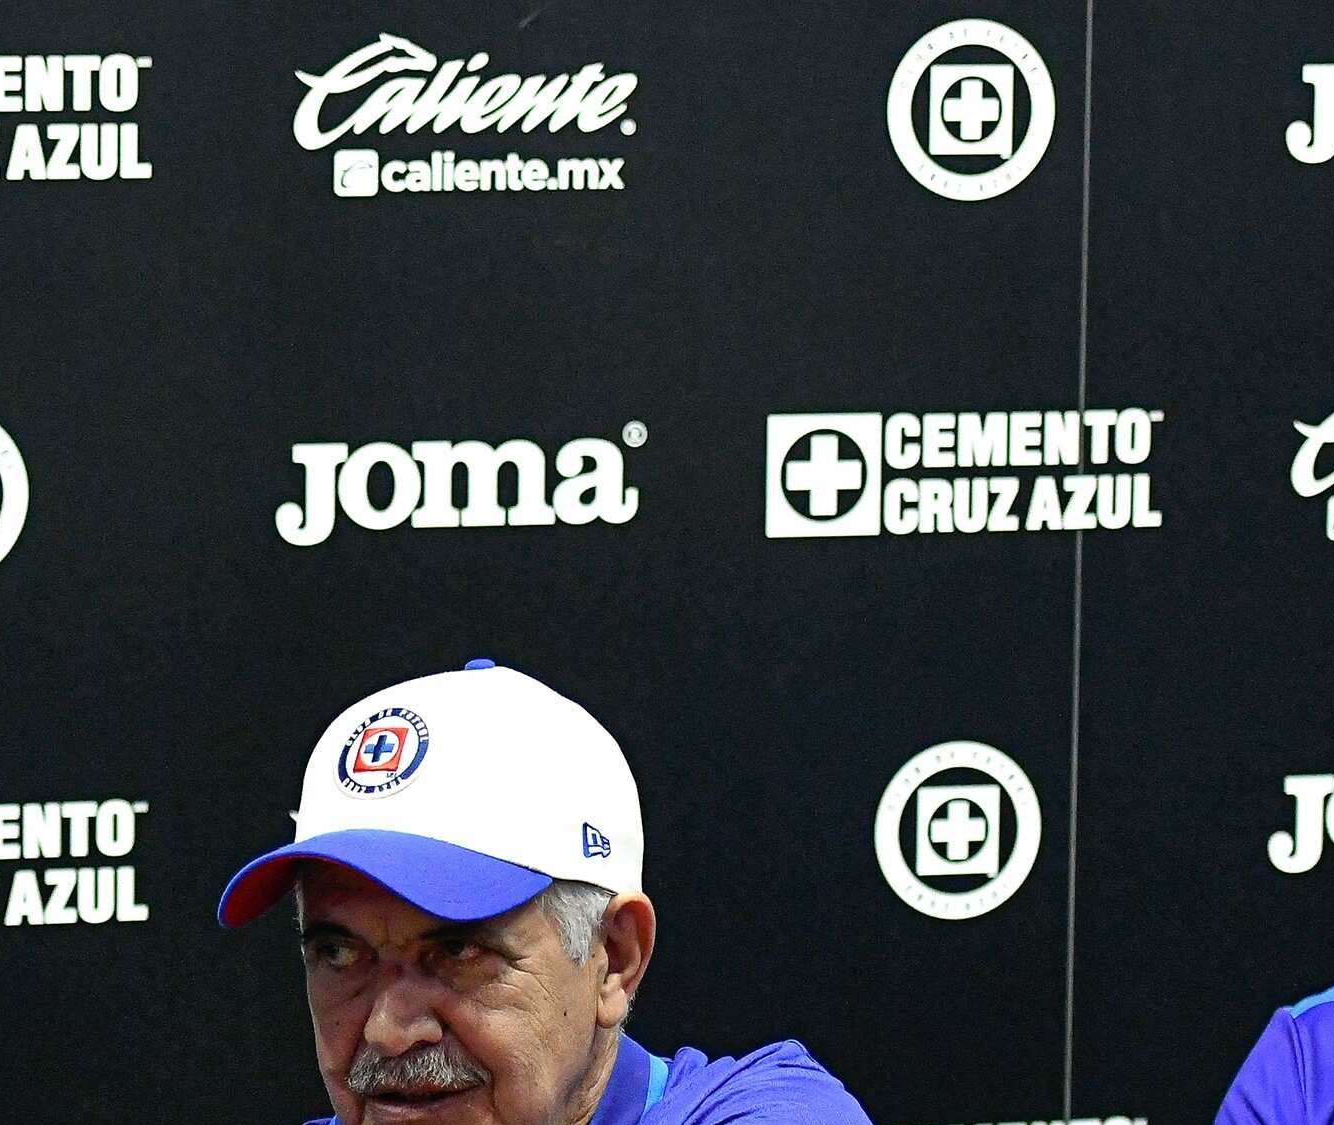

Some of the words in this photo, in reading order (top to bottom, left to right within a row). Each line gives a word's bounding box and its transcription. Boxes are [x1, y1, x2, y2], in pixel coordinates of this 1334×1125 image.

[294, 33, 633, 150] Caliente
[6, 123, 152, 180] AZUL
[381, 150, 625, 193] caliente.mx
[884, 409, 1152, 470] CEMENTO
[884, 477, 1019, 534] CRUZ
[1026, 472, 1162, 530] AZUL
[5, 866, 148, 926] AZUL
